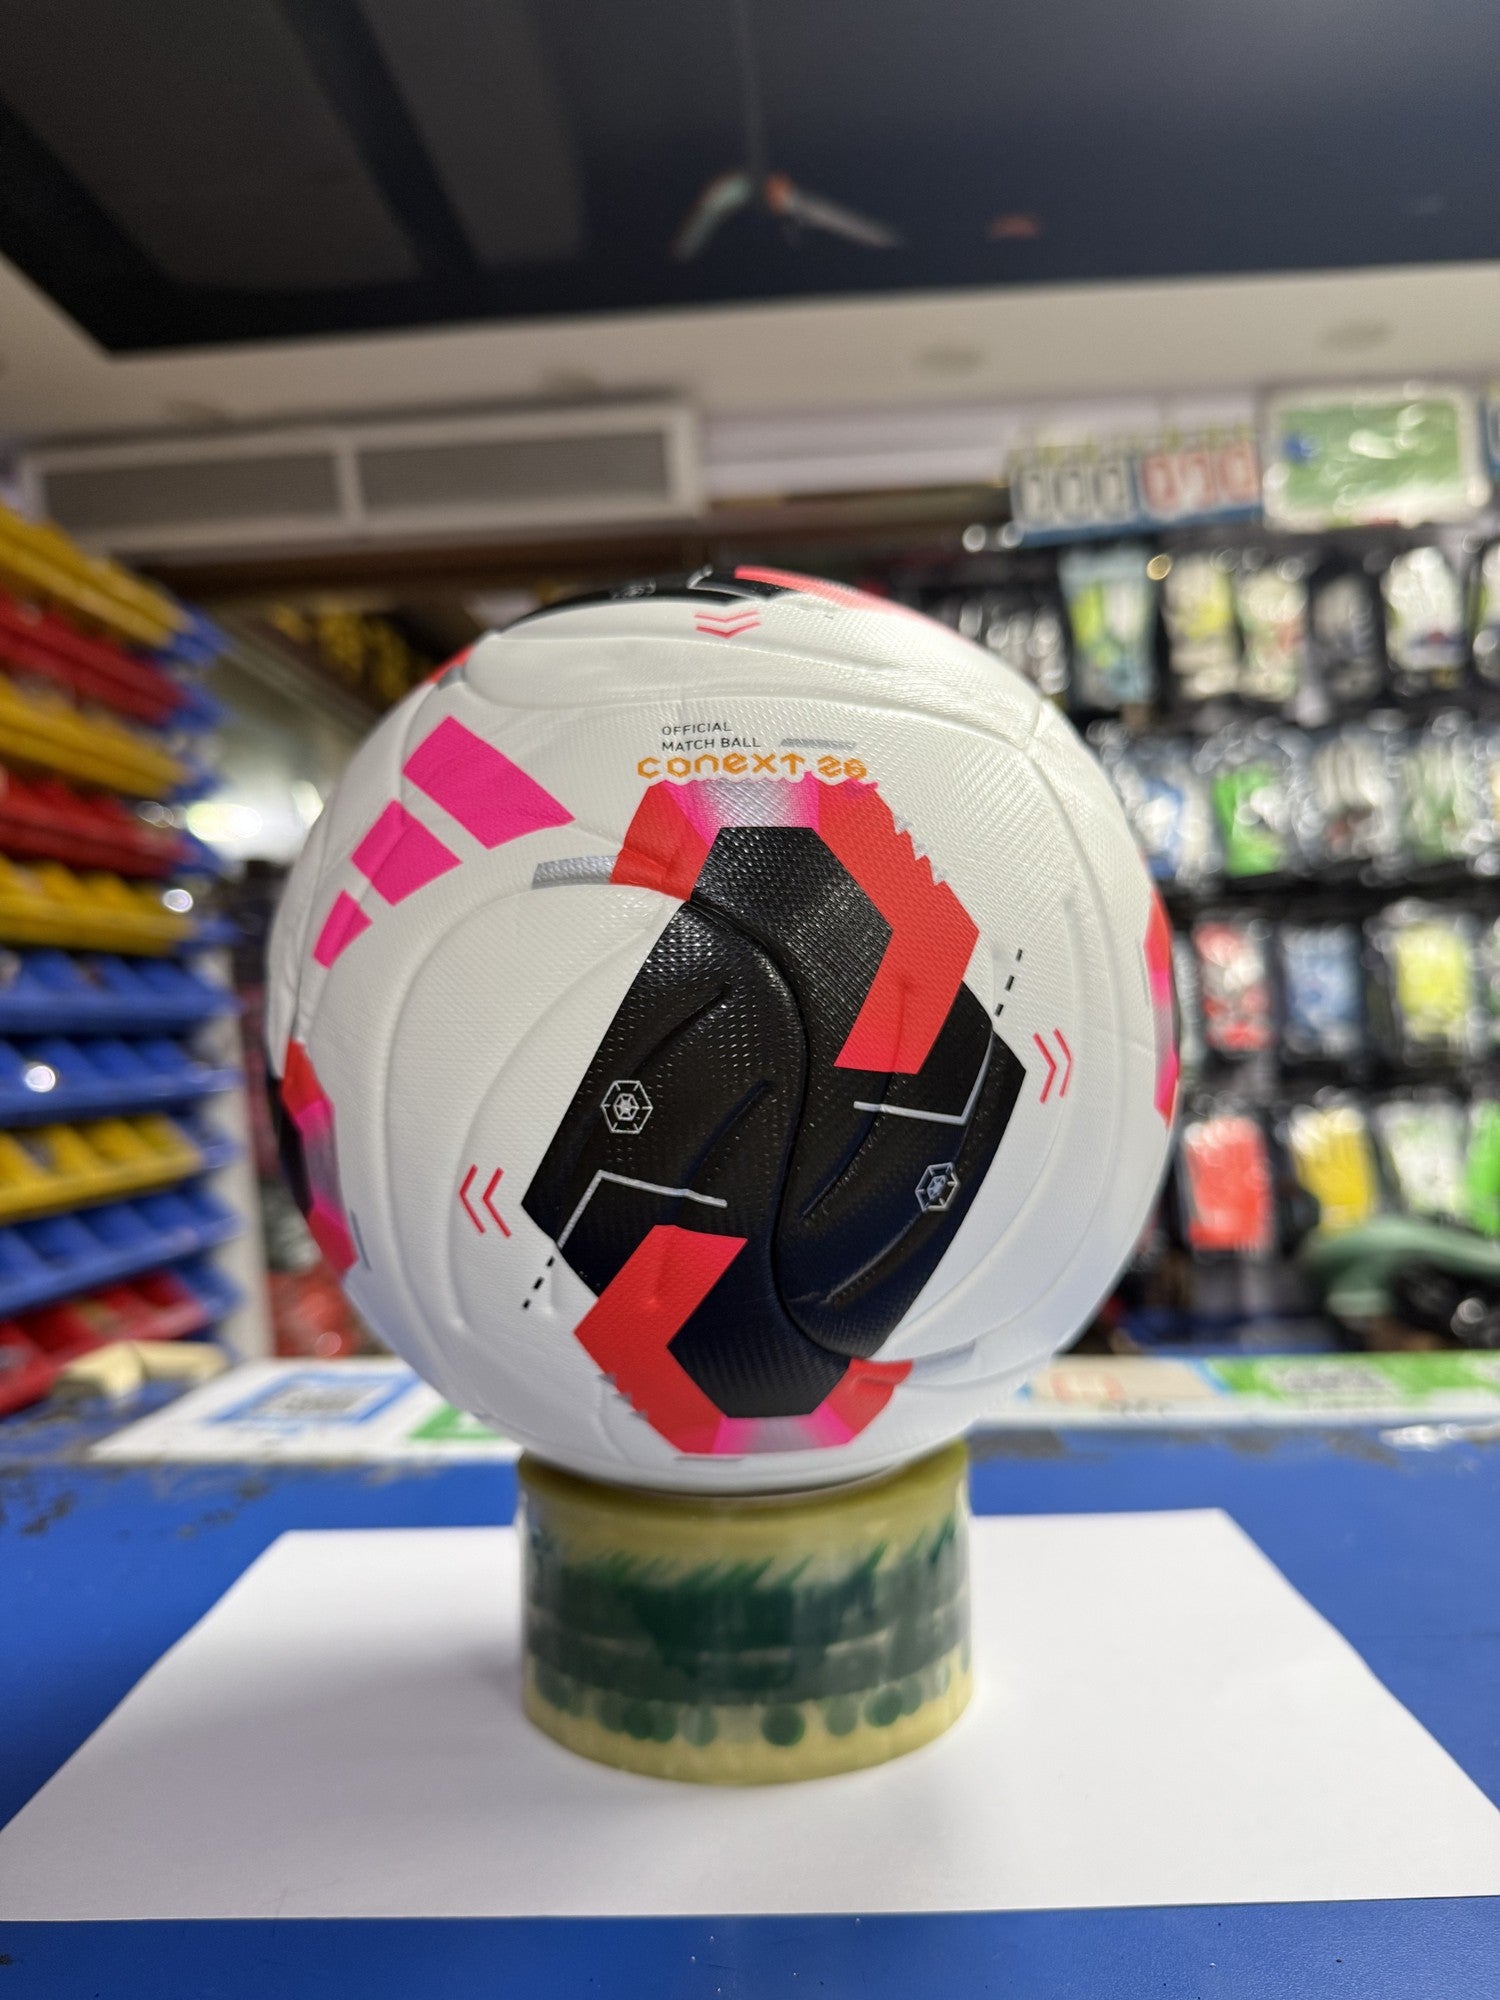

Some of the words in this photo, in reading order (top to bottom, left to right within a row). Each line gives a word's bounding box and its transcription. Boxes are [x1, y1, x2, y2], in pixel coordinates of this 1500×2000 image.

[661, 721, 733, 736] OFFICIAL
[661, 738, 716, 752] MATCH
[720, 737, 762, 749] BALL
